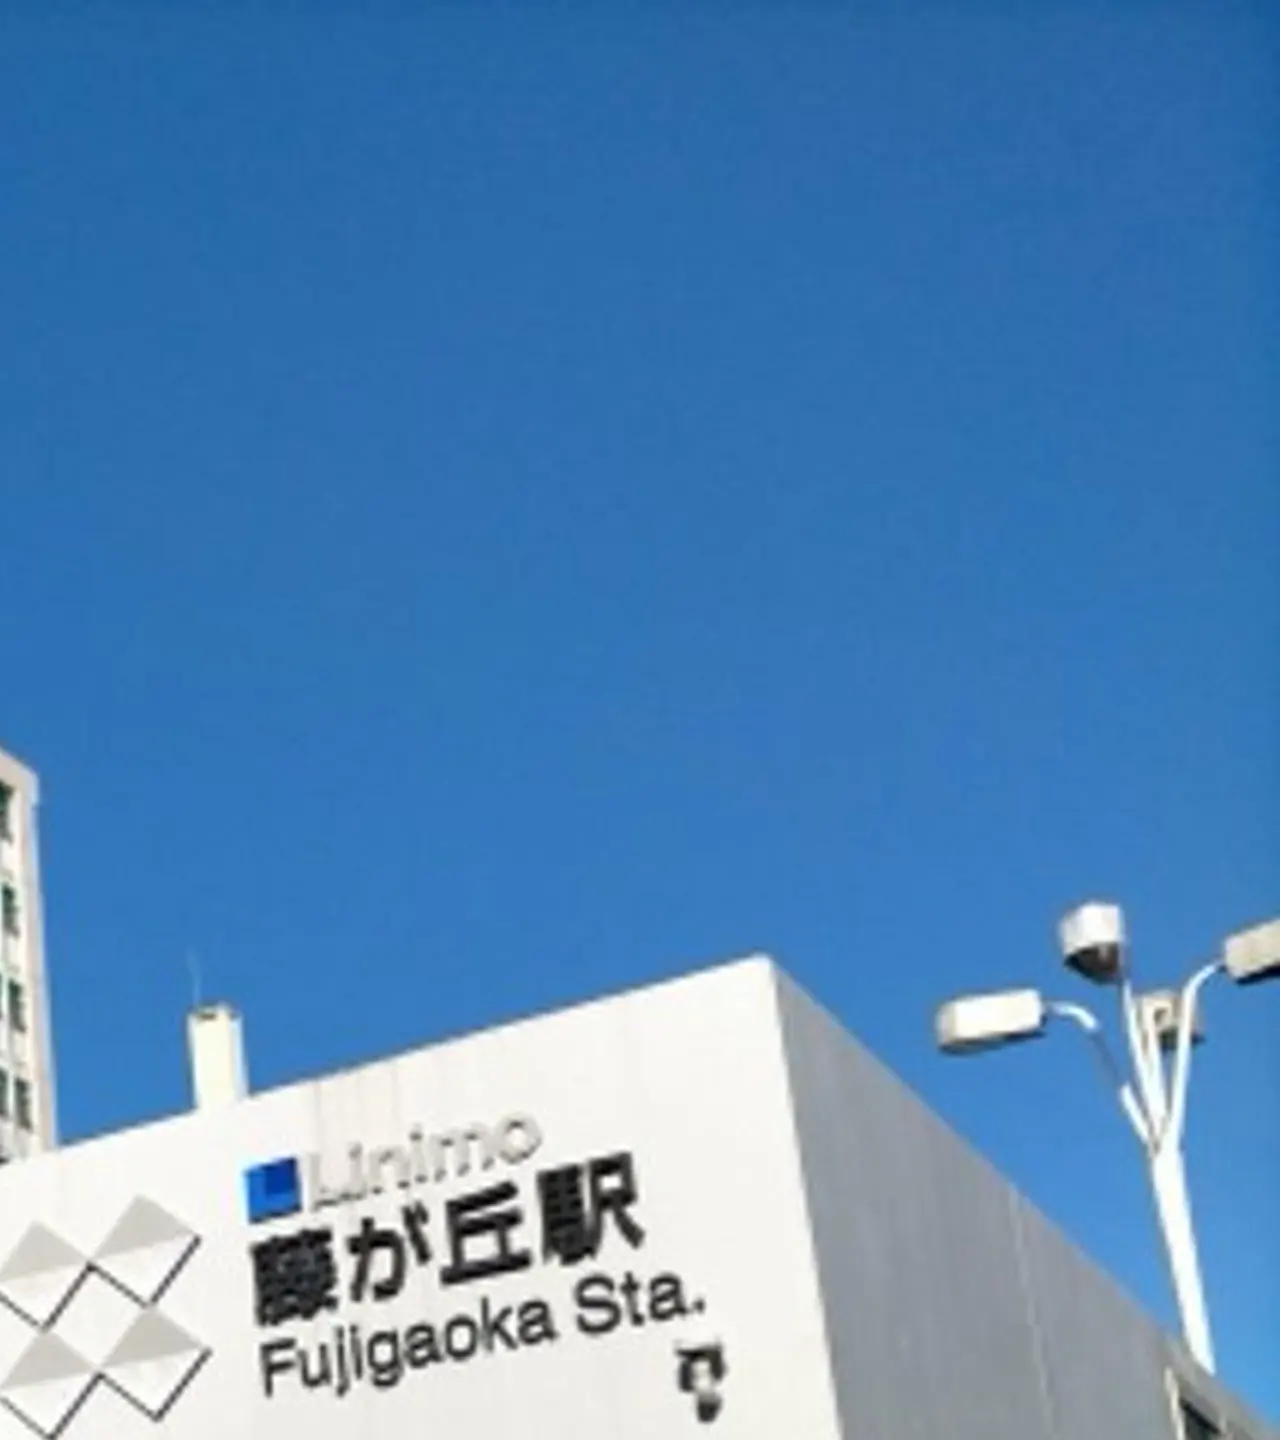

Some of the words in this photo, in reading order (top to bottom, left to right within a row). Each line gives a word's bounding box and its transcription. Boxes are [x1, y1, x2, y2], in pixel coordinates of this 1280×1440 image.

[307, 1113, 543, 1209] Linimo
[250, 1151, 645, 1327] 藤が丘駅
[259, 1296, 559, 1398] Fujigaoka
[573, 1271, 706, 1336] Sta.
